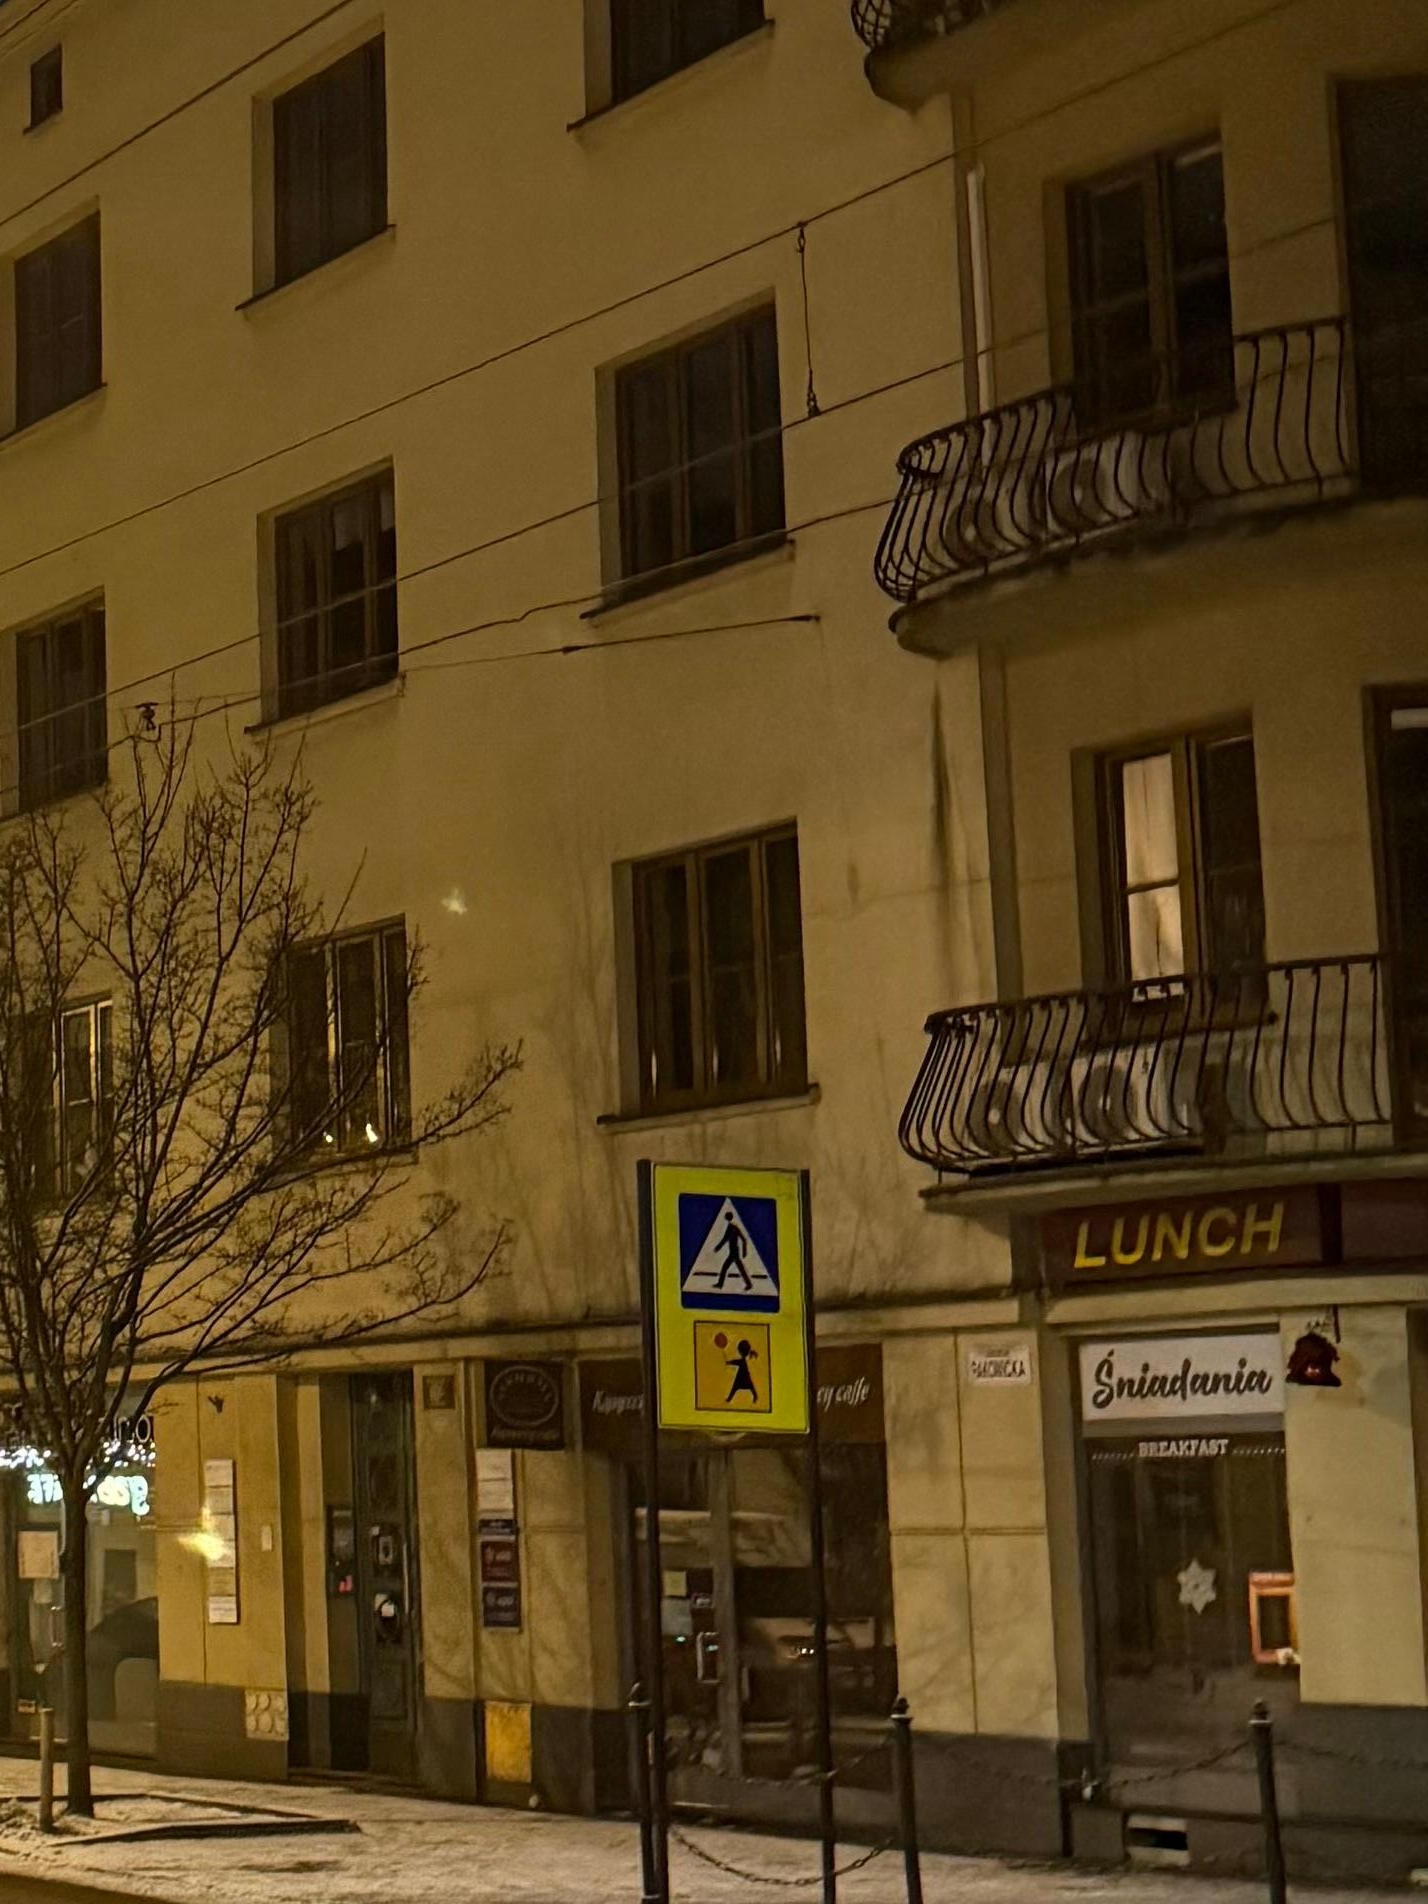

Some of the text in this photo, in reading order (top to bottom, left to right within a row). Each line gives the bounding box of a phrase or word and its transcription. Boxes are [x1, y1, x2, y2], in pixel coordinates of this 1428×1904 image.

[1074, 1201, 1284, 1268] LUNCH
[1092, 1348, 1272, 1409] Śniadania
[1138, 1438, 1229, 1458] BREAKFAST
